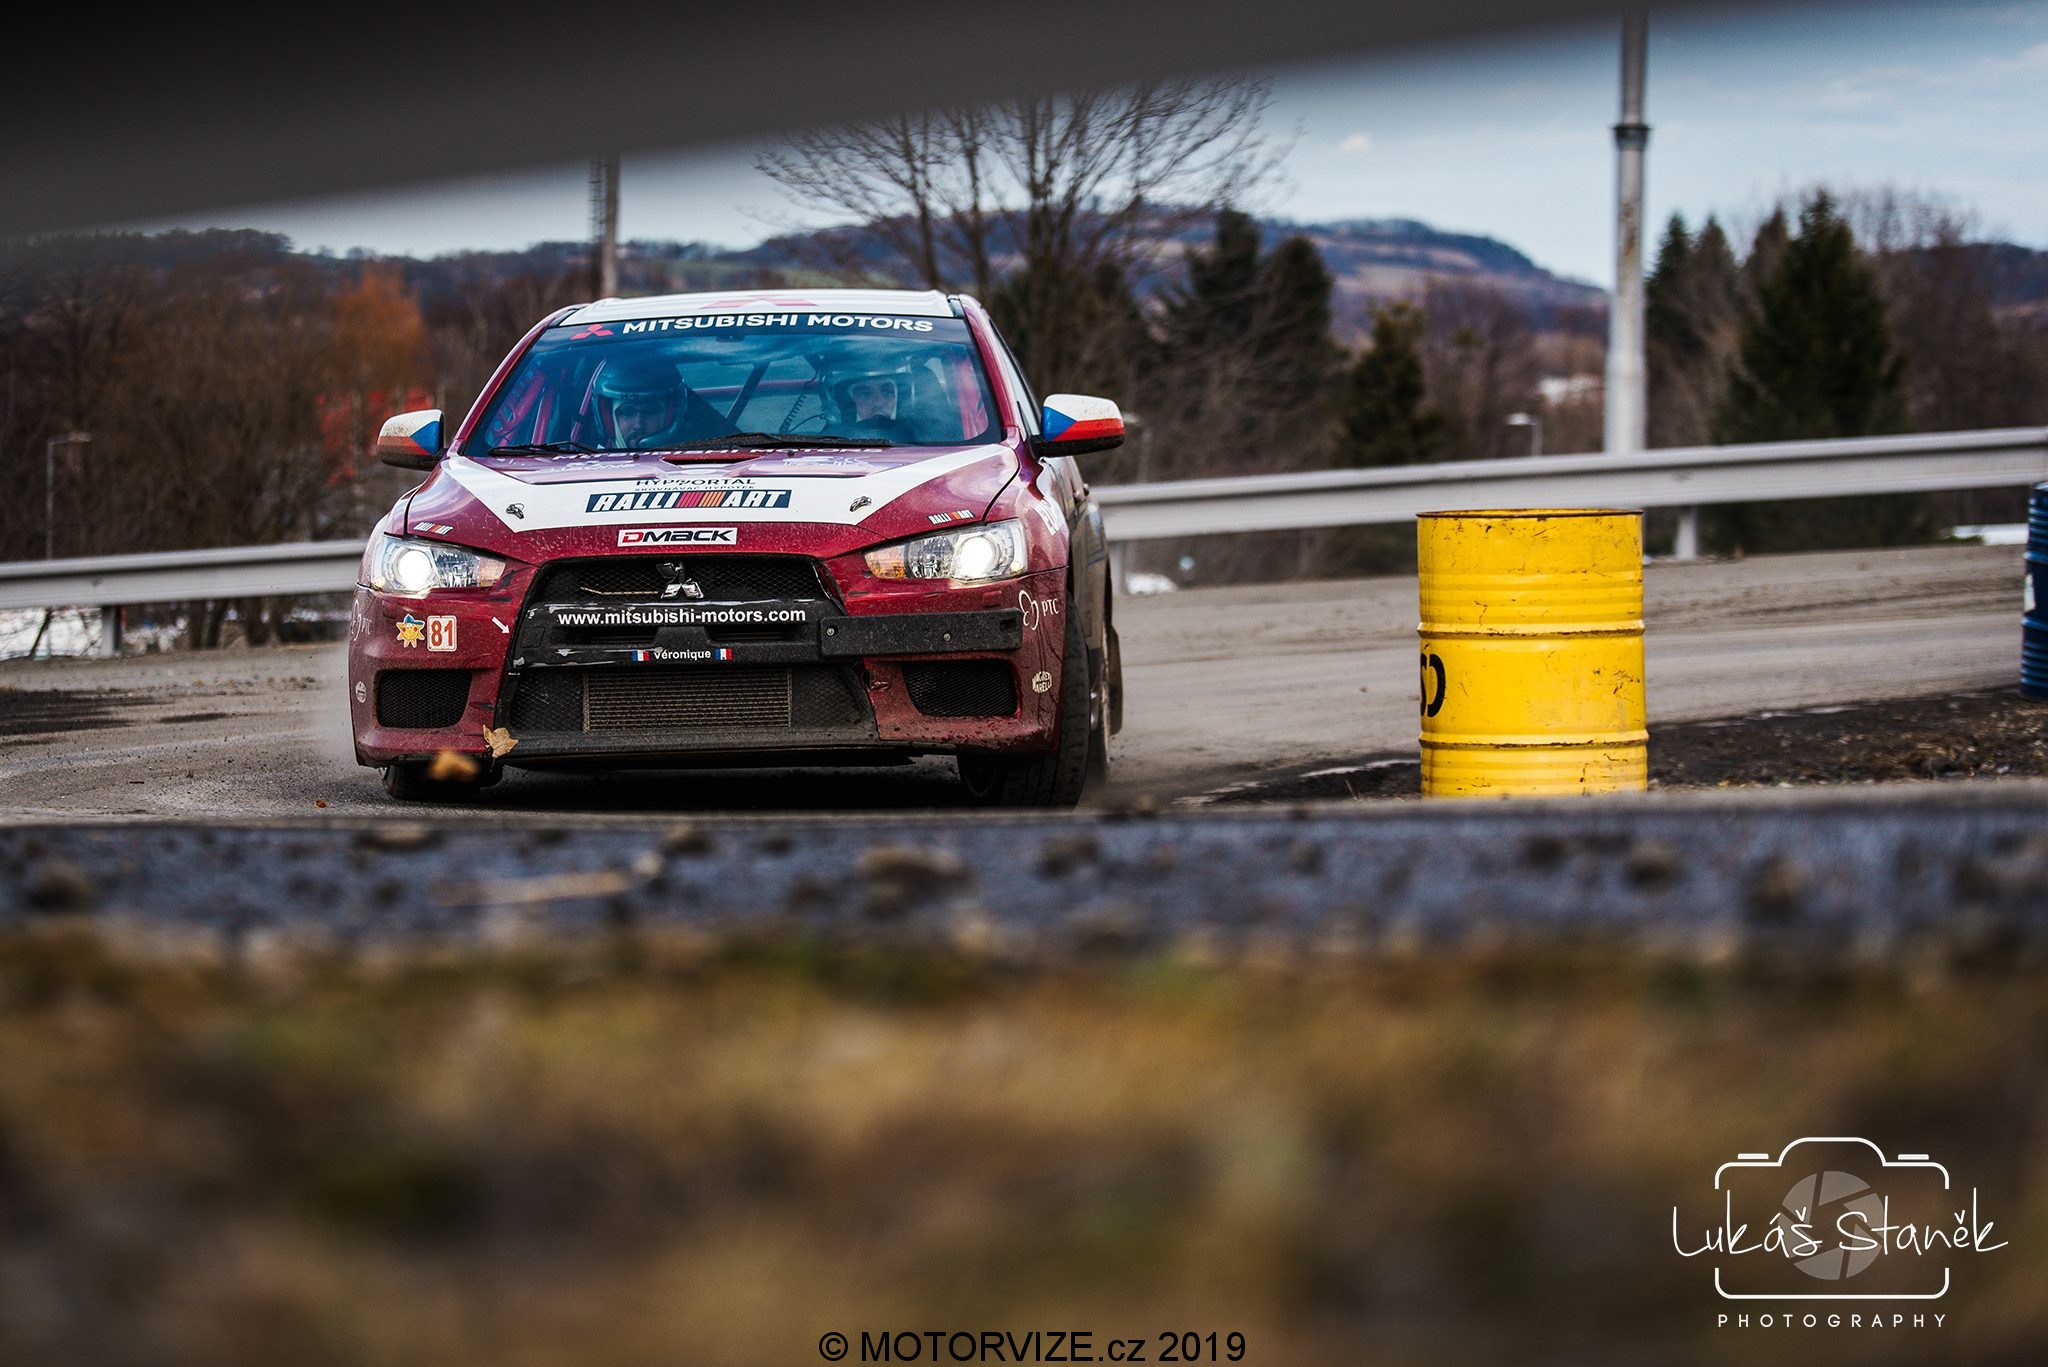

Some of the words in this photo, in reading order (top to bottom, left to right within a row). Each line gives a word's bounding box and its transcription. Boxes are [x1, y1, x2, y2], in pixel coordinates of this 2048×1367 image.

[622, 313, 798, 335] MITSUBISHI
[807, 314, 935, 333] MOTORS
[558, 608, 806, 625] www.mitsubishi-motors.com
[1041, 598, 1060, 617] PTC
[431, 620, 454, 647] 81
